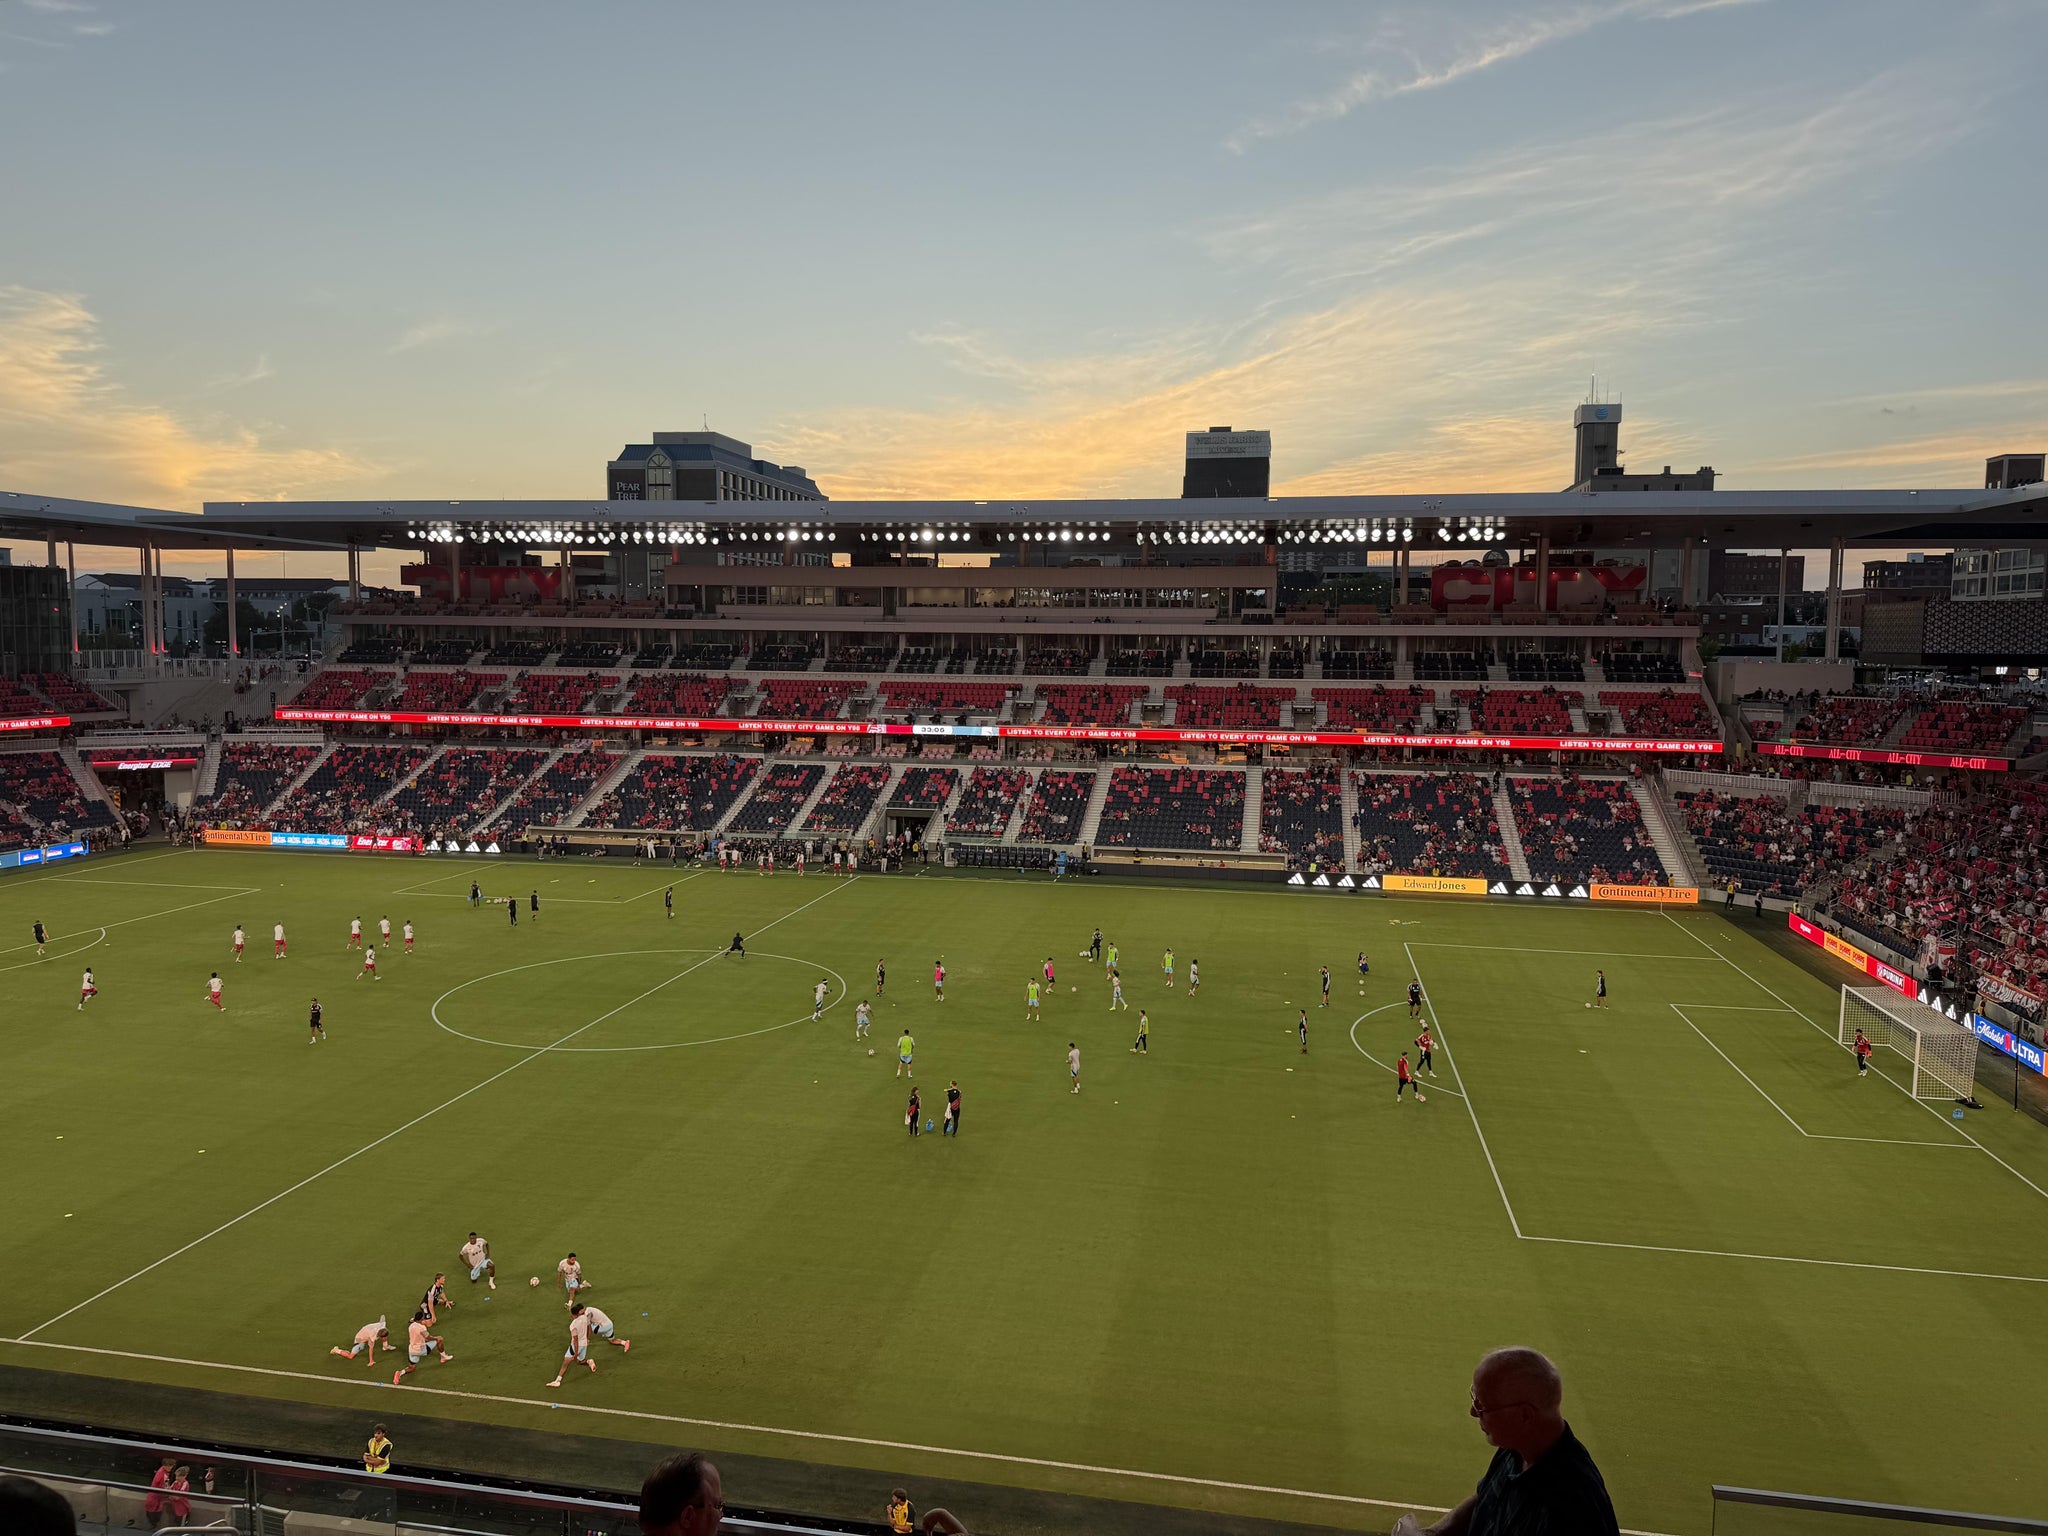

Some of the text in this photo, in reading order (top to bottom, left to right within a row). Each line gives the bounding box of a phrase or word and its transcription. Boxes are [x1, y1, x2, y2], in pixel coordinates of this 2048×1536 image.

[616, 482, 640, 491] PEAR
[616, 492, 639, 500] TREE
[1430, 567, 1647, 611] CITY
[118, 762, 150, 770] Energizer
[204, 831, 243, 840] ontinental
[249, 832, 267, 841] Tire
[1403, 879, 1466, 890] Edward Jones
[1598, 886, 1691, 898] Continental Tire
[1883, 968, 1903, 988] PURINA
[1977, 1020, 2041, 1067] Michelob ULTRA
